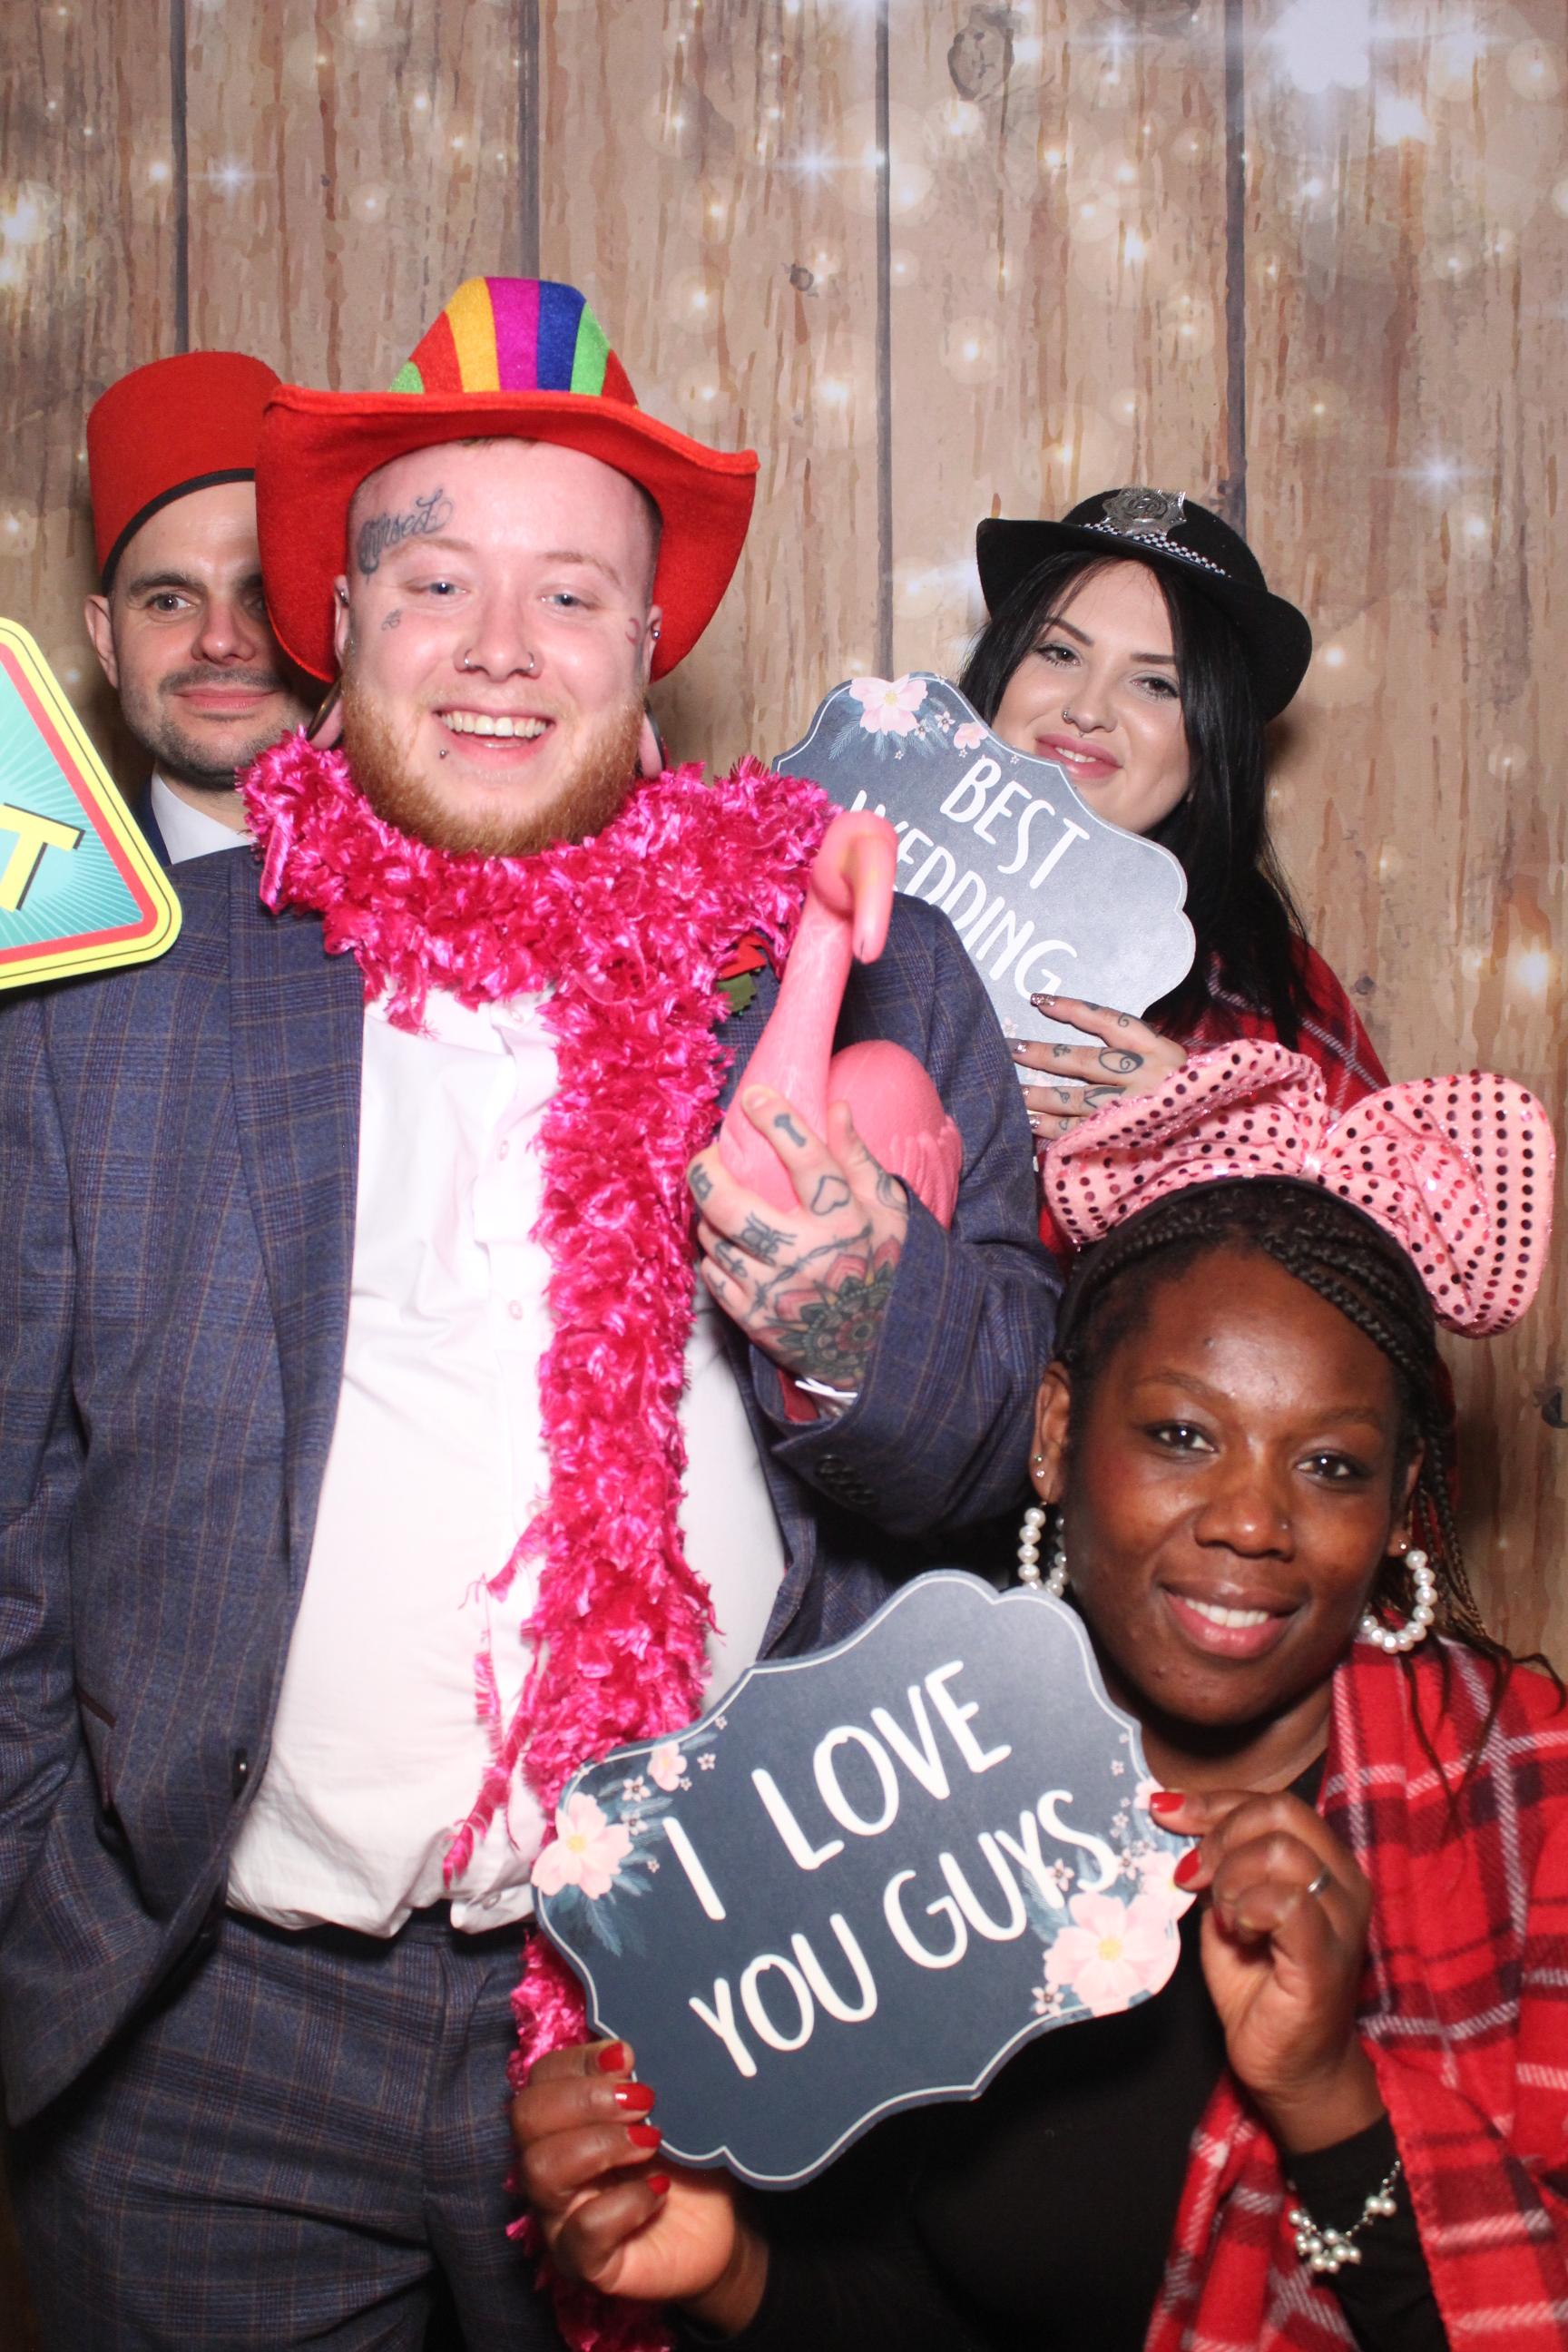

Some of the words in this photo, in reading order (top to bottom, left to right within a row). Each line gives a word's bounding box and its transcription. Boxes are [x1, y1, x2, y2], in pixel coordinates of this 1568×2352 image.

[940, 758, 1089, 889] BEST
[662, 1818, 726, 1920] I
[752, 1661, 1012, 1870] LOVE
[689, 1914, 878, 2077] YOU
[883, 1789, 1120, 1969] GUYS
